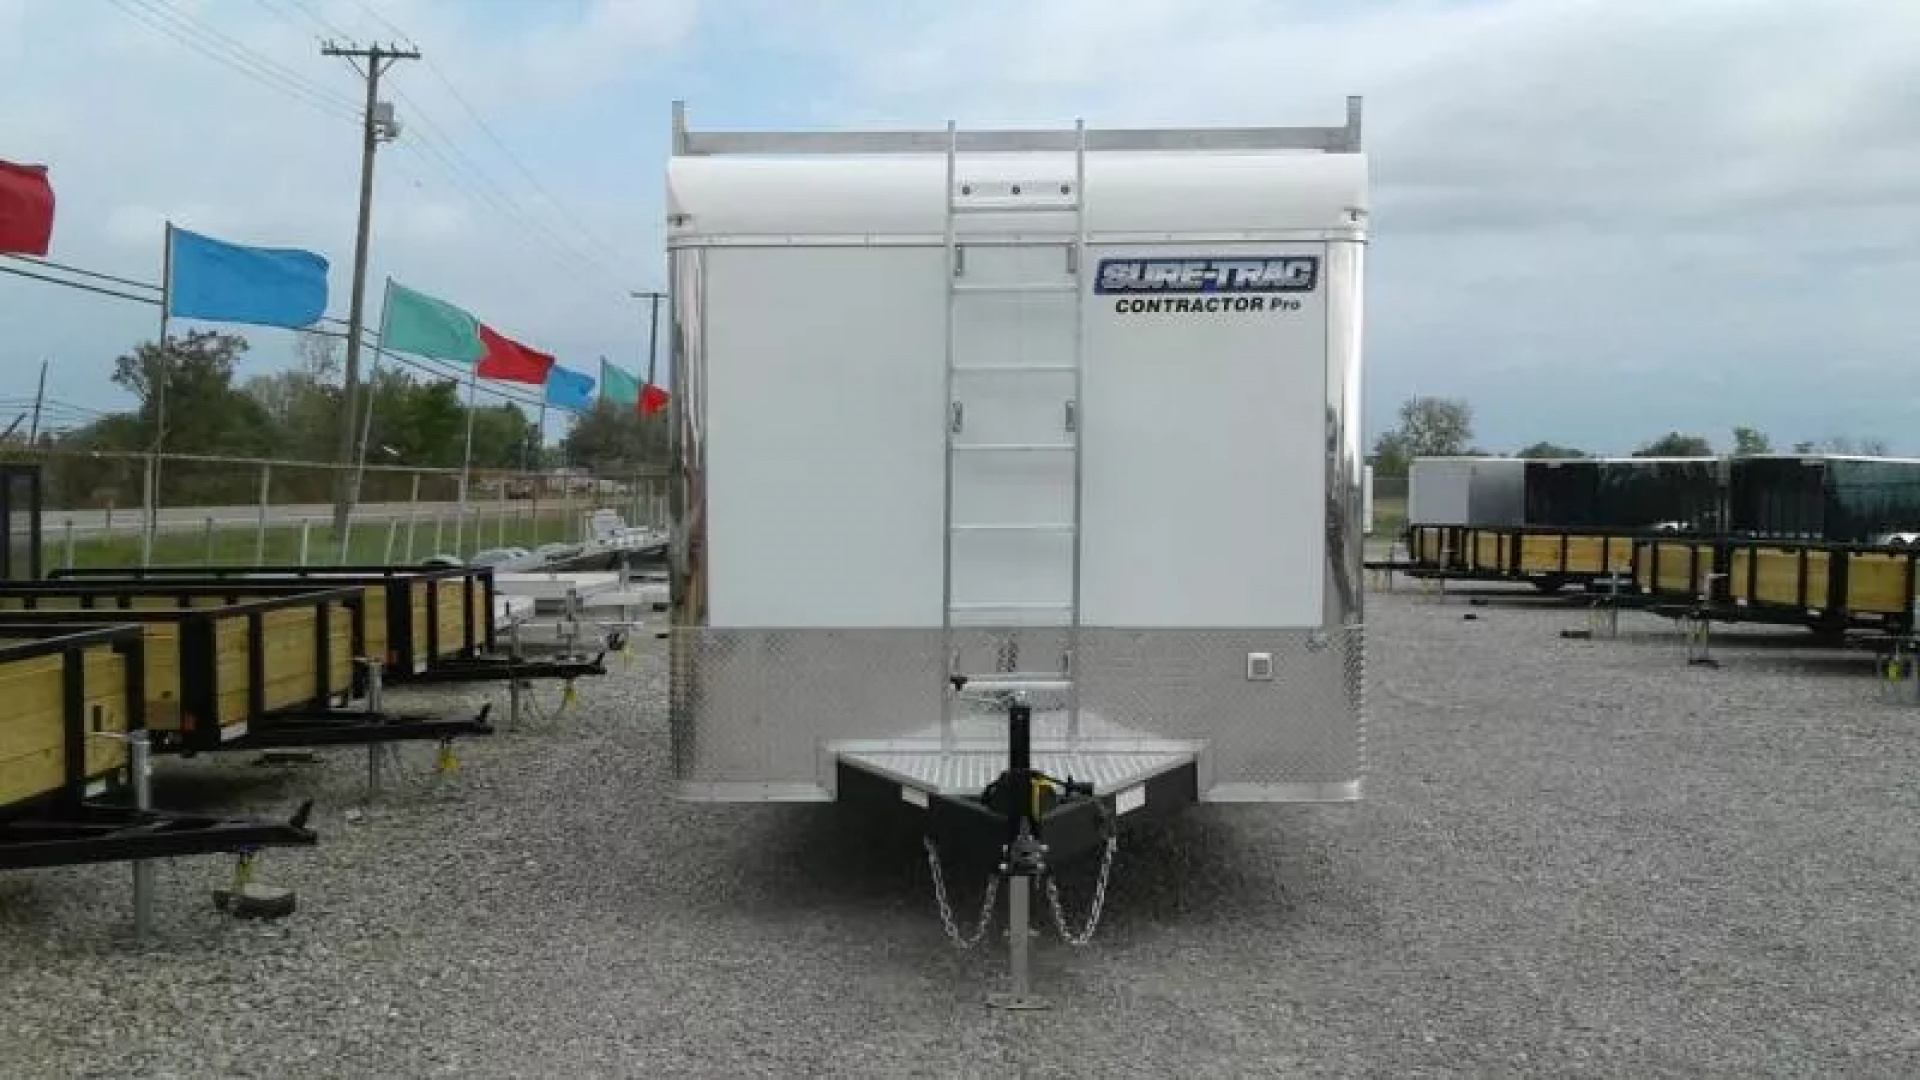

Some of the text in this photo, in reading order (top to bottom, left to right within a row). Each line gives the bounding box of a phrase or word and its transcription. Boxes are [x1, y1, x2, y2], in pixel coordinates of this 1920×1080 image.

[1101, 260, 1314, 289] SURE-TRAC
[1115, 297, 1301, 313] CONTRACTOR Pro
